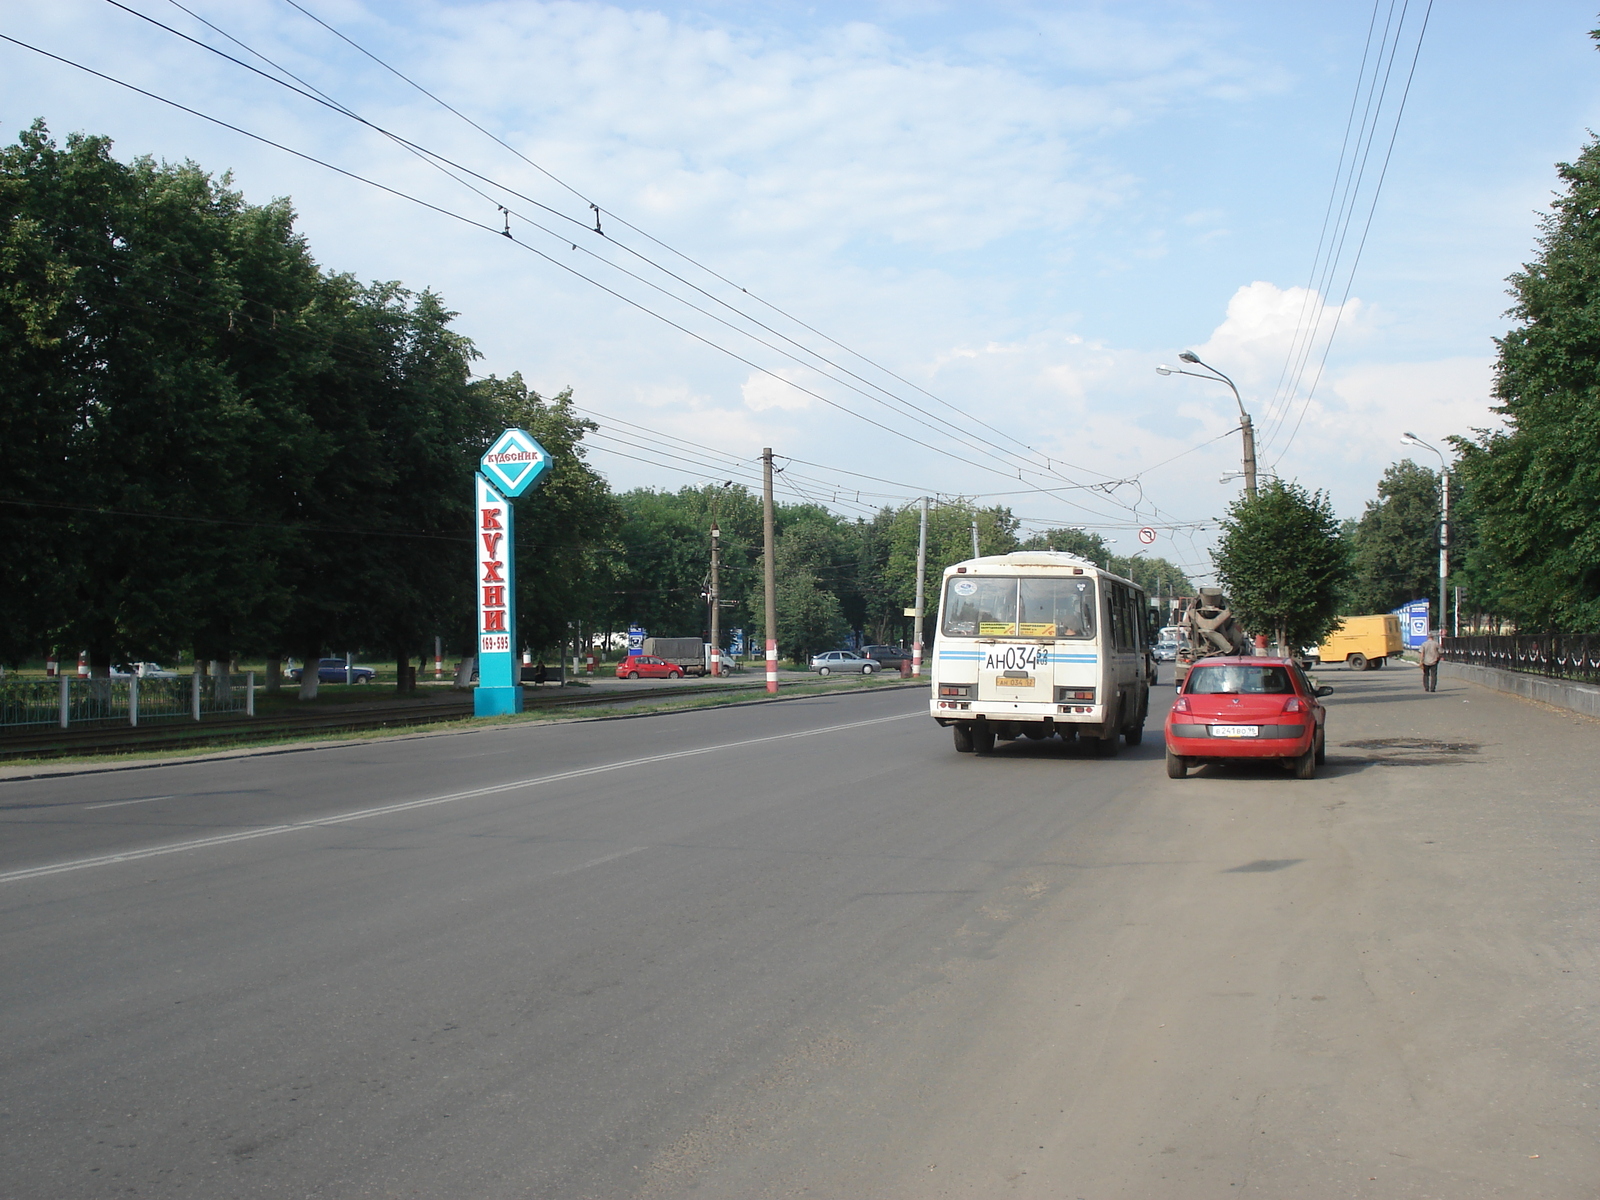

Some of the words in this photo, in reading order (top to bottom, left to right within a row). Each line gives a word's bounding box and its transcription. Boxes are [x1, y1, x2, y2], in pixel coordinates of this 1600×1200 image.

[481, 508, 505, 631] КУХНИ
[482, 636, 509, 650] 169-595
[1036, 649, 1049, 659] 52
